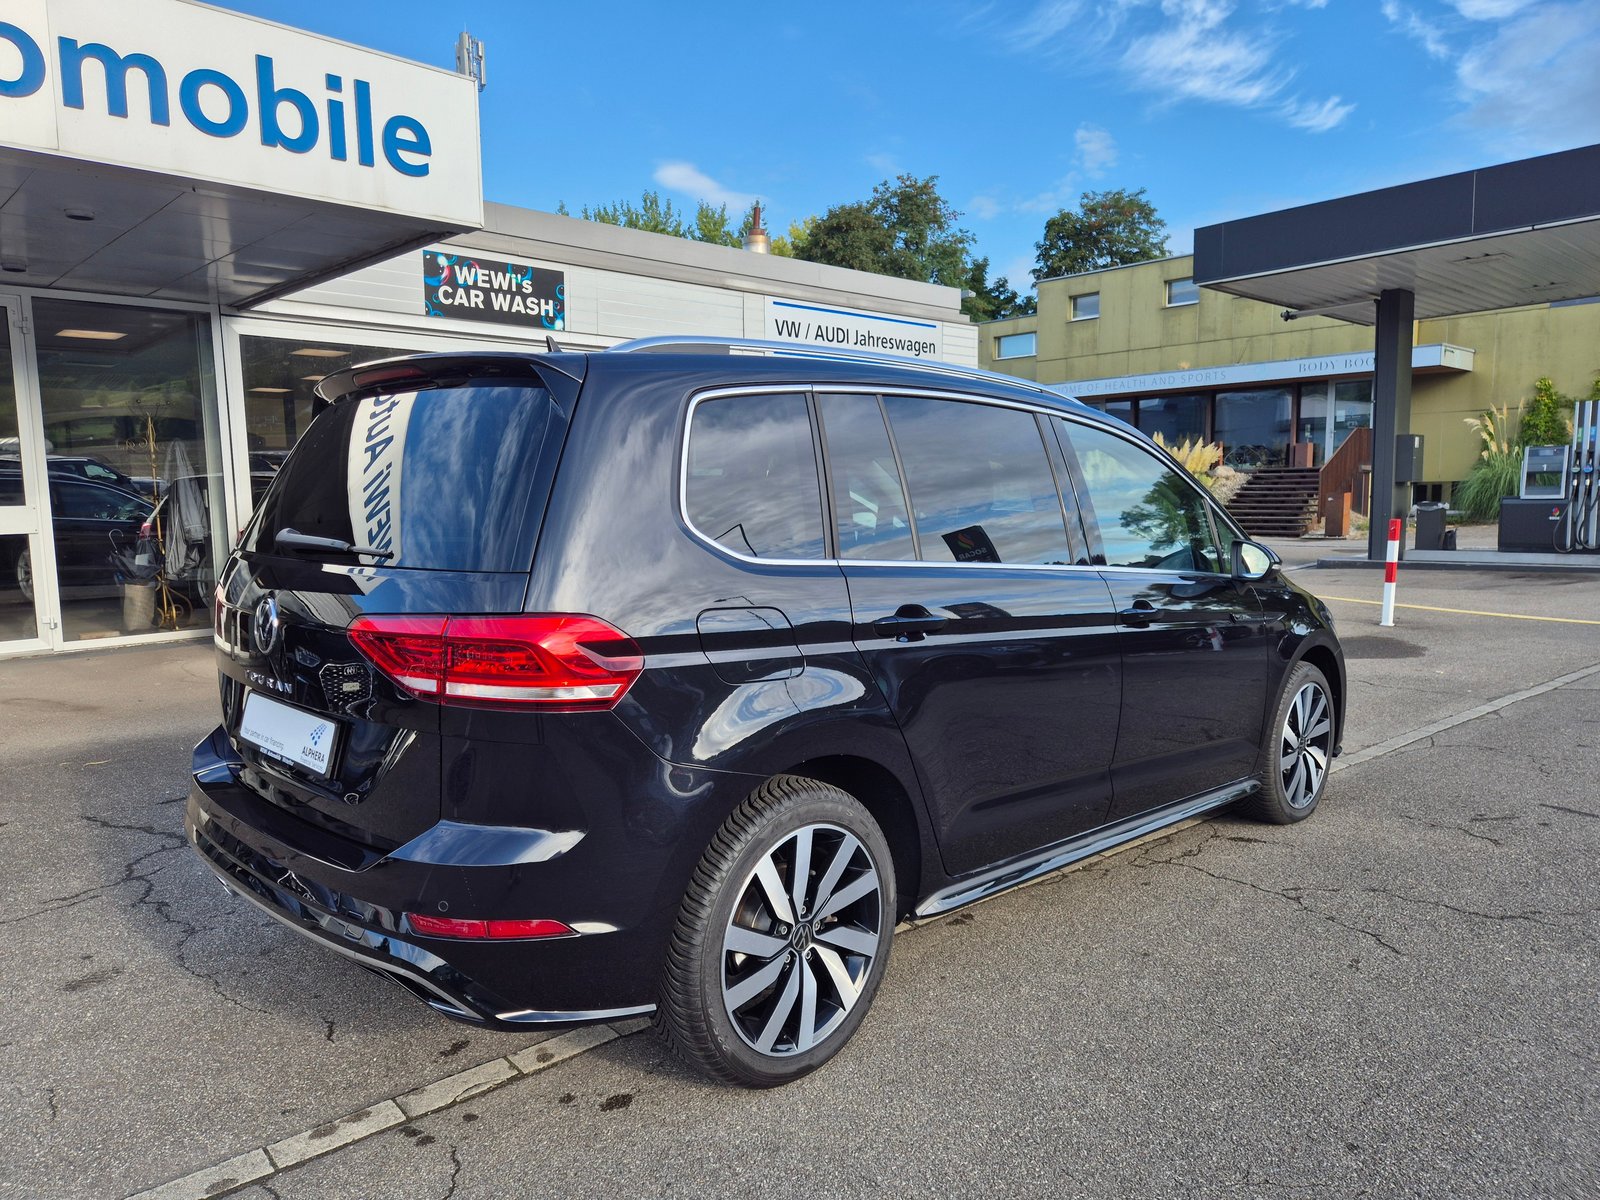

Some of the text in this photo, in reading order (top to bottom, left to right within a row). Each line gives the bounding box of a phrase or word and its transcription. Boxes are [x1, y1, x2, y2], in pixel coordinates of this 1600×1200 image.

[0, 20, 433, 178] omobile
[454, 264, 533, 294] WEWi's
[438, 285, 554, 317] CAR WASH
[775, 318, 936, 357] VW / AUDI Jahreswagen
[1299, 360, 1336, 373] BODY
[1086, 382, 1100, 393] OF
[1105, 378, 1146, 391] HEALTH
[1151, 374, 1176, 386] AND
[1177, 371, 1226, 383] SPORTS
[245, 669, 293, 694] TOURAN
[302, 746, 325, 762] ALPHERA
